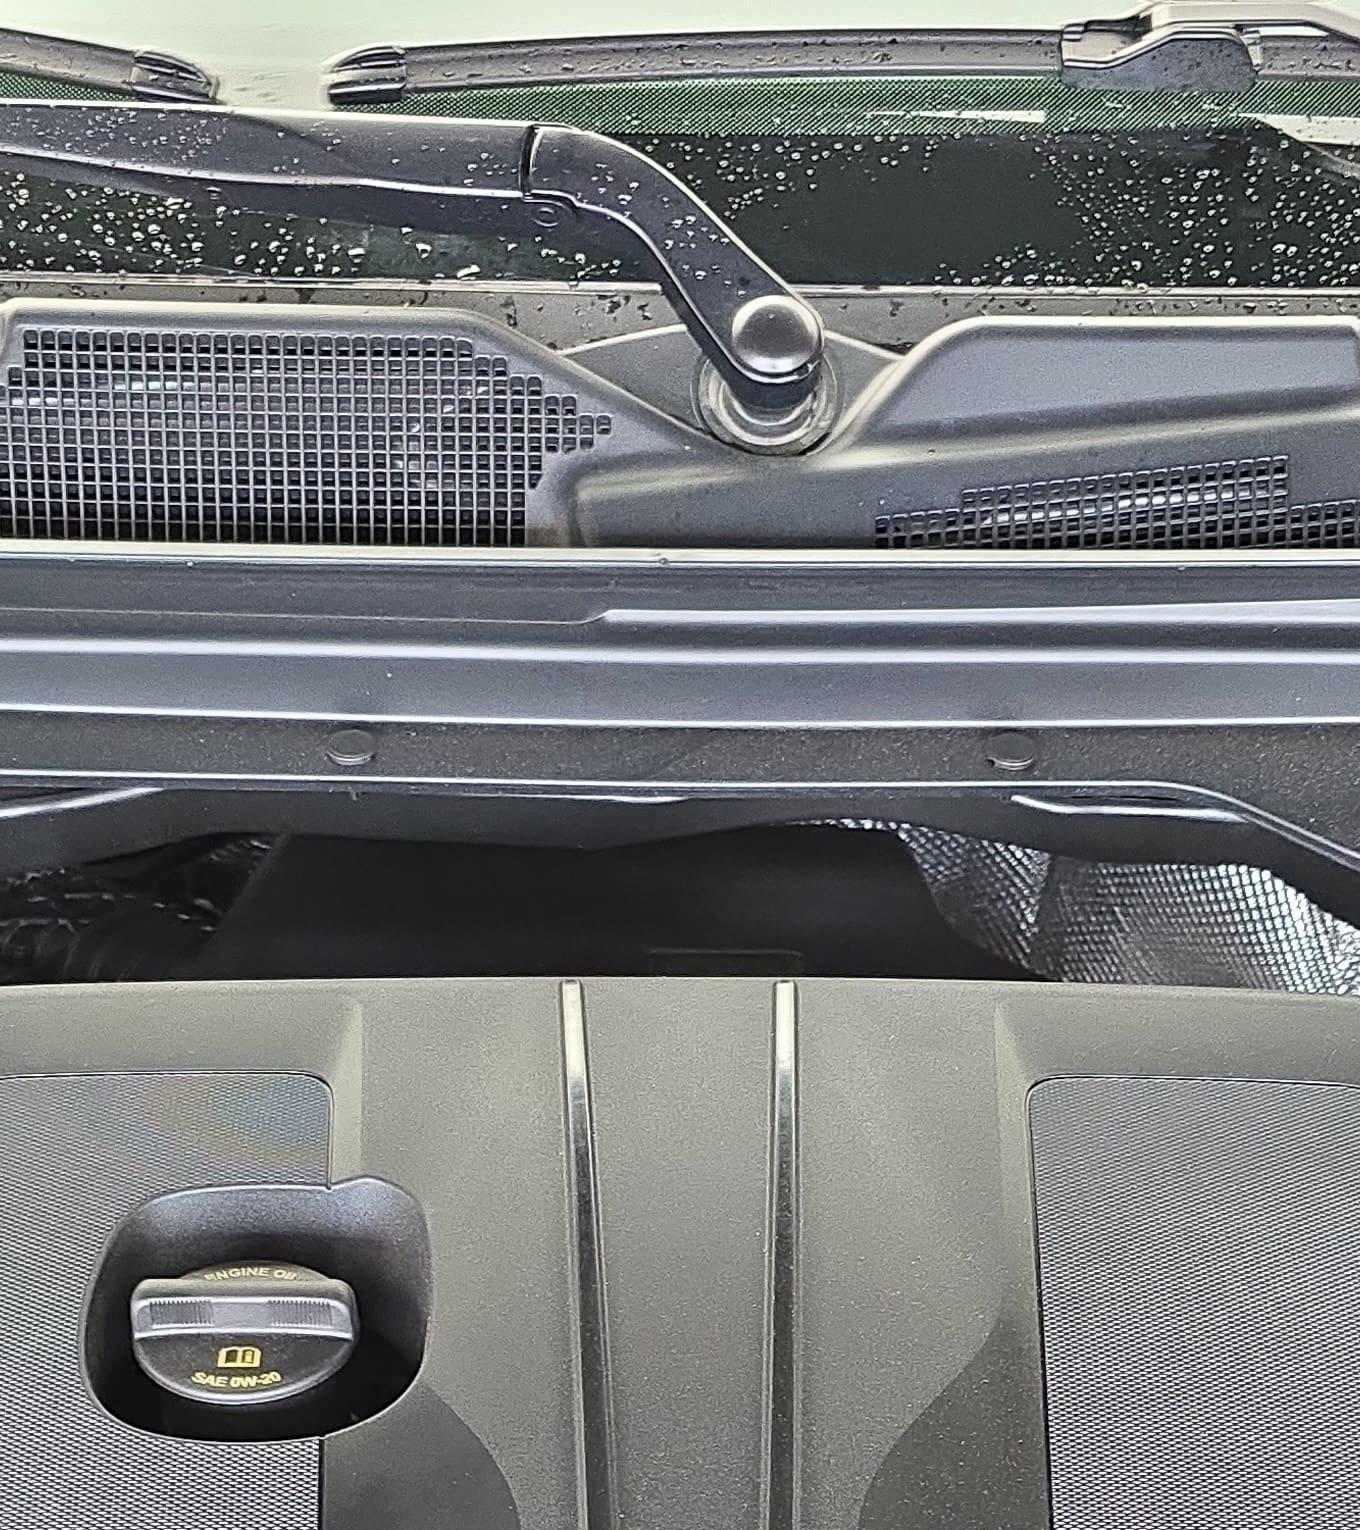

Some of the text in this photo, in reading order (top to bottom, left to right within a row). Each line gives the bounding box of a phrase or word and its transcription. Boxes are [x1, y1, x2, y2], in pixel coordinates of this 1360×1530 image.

[204, 1266, 270, 1282] ENGINE
[191, 1370, 282, 1388] SAE 0W-20
